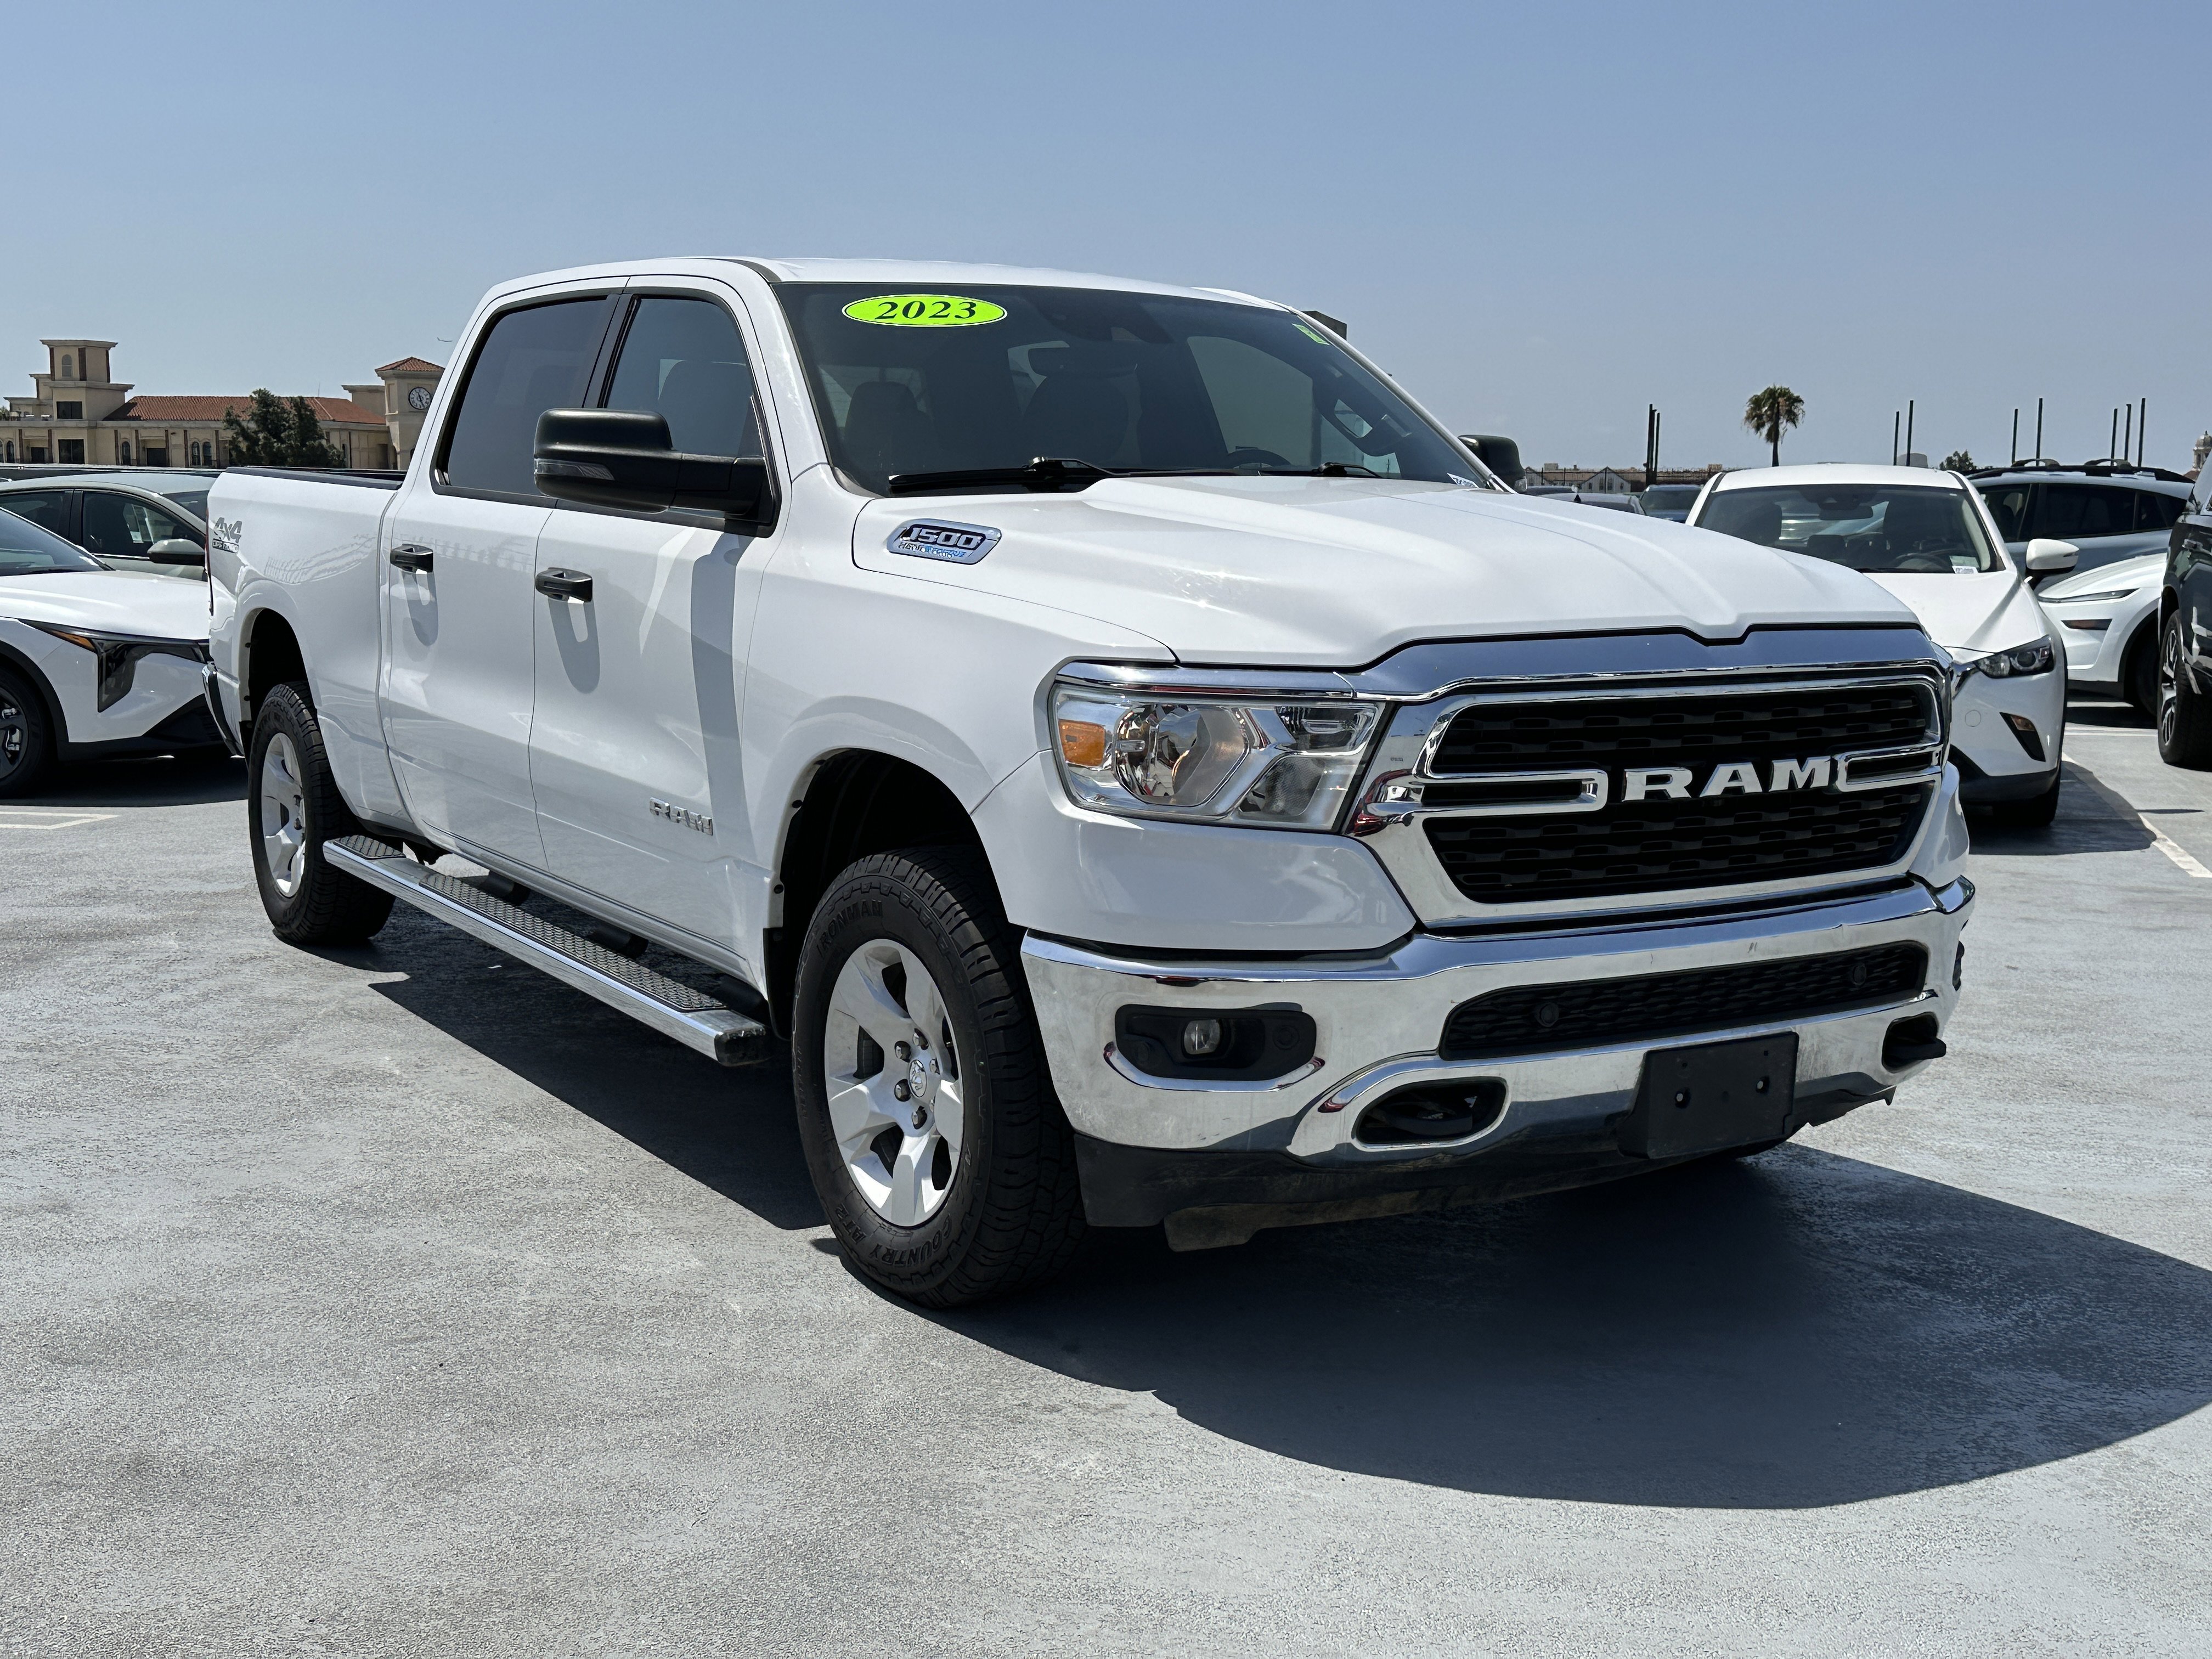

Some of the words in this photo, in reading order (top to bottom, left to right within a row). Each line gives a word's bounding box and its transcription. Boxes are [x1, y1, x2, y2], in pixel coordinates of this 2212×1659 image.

[874, 301, 977, 320] 2023
[910, 527, 983, 549] 1500
[1621, 755, 1832, 803] RAM
[650, 797, 714, 836] RAM
[817, 899, 884, 958] IRONMAN
[868, 1213, 953, 1267] COUNTRY
